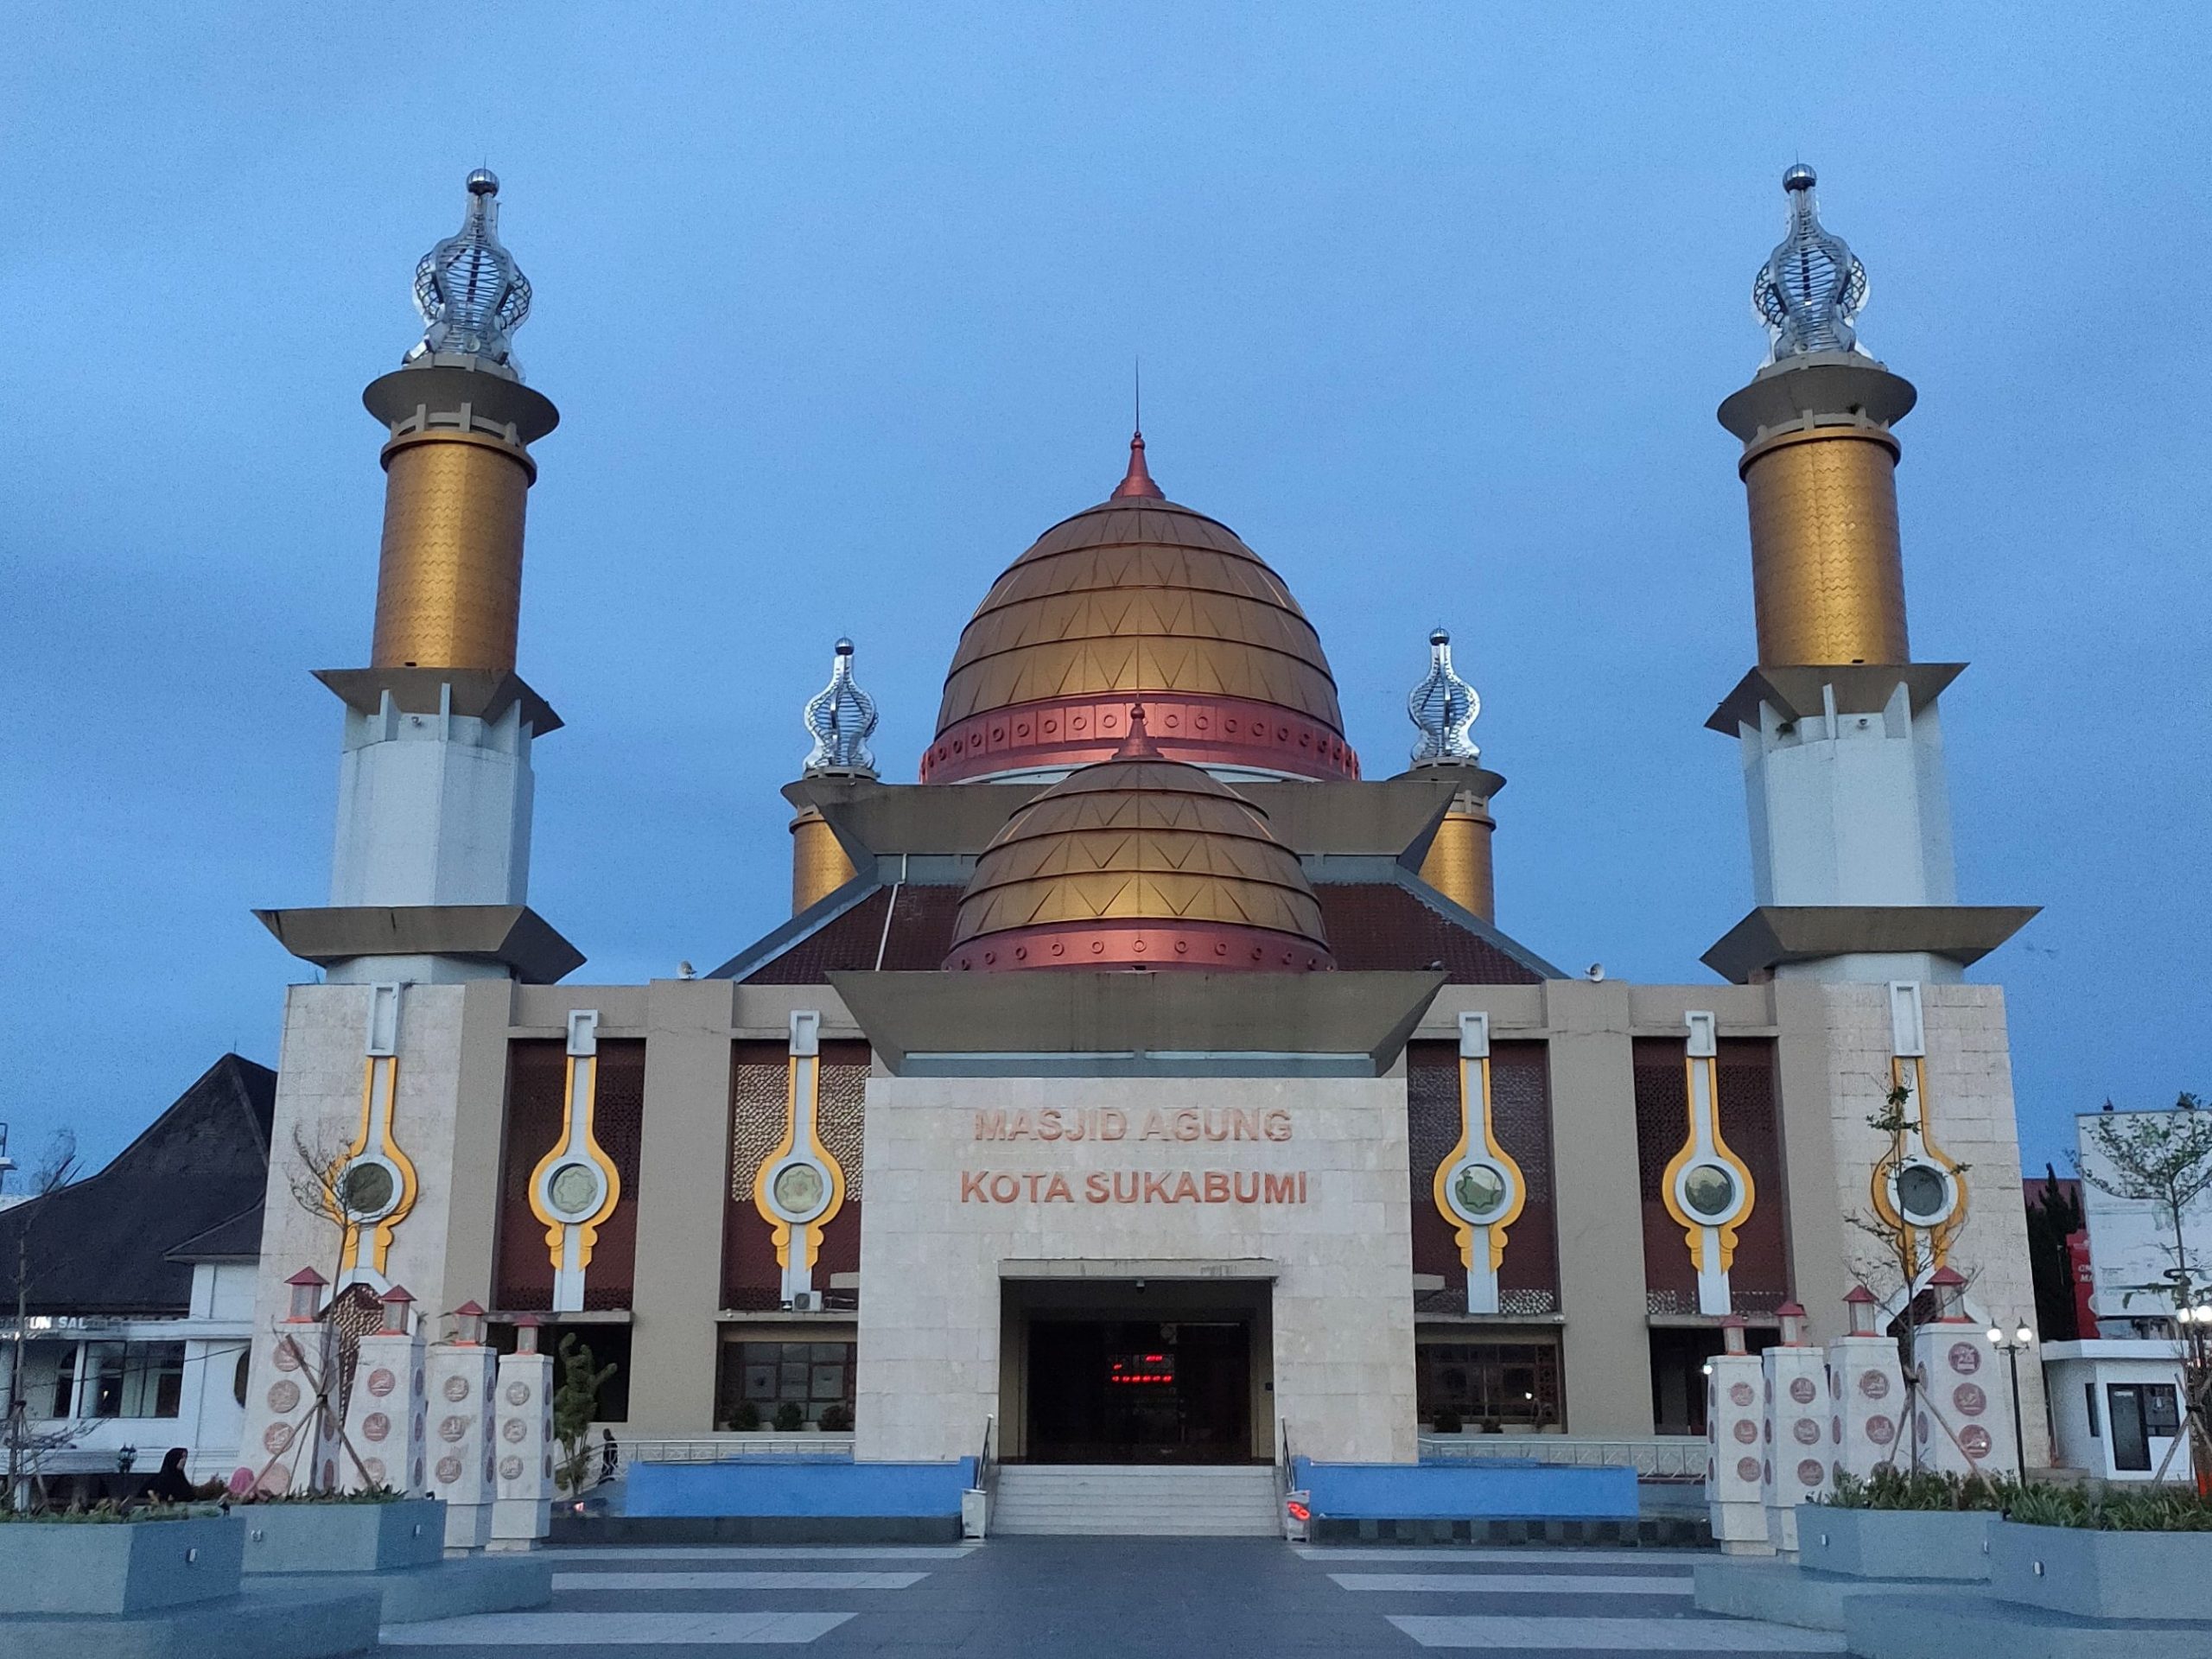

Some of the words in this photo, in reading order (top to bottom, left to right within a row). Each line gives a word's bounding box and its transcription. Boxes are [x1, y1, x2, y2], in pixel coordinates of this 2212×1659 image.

[975, 1109, 1127, 1141] MASJID
[1139, 1109, 1293, 1141] AGUNG
[961, 1170, 1075, 1204] KOTA
[1085, 1170, 1306, 1204] SUKABUMI
